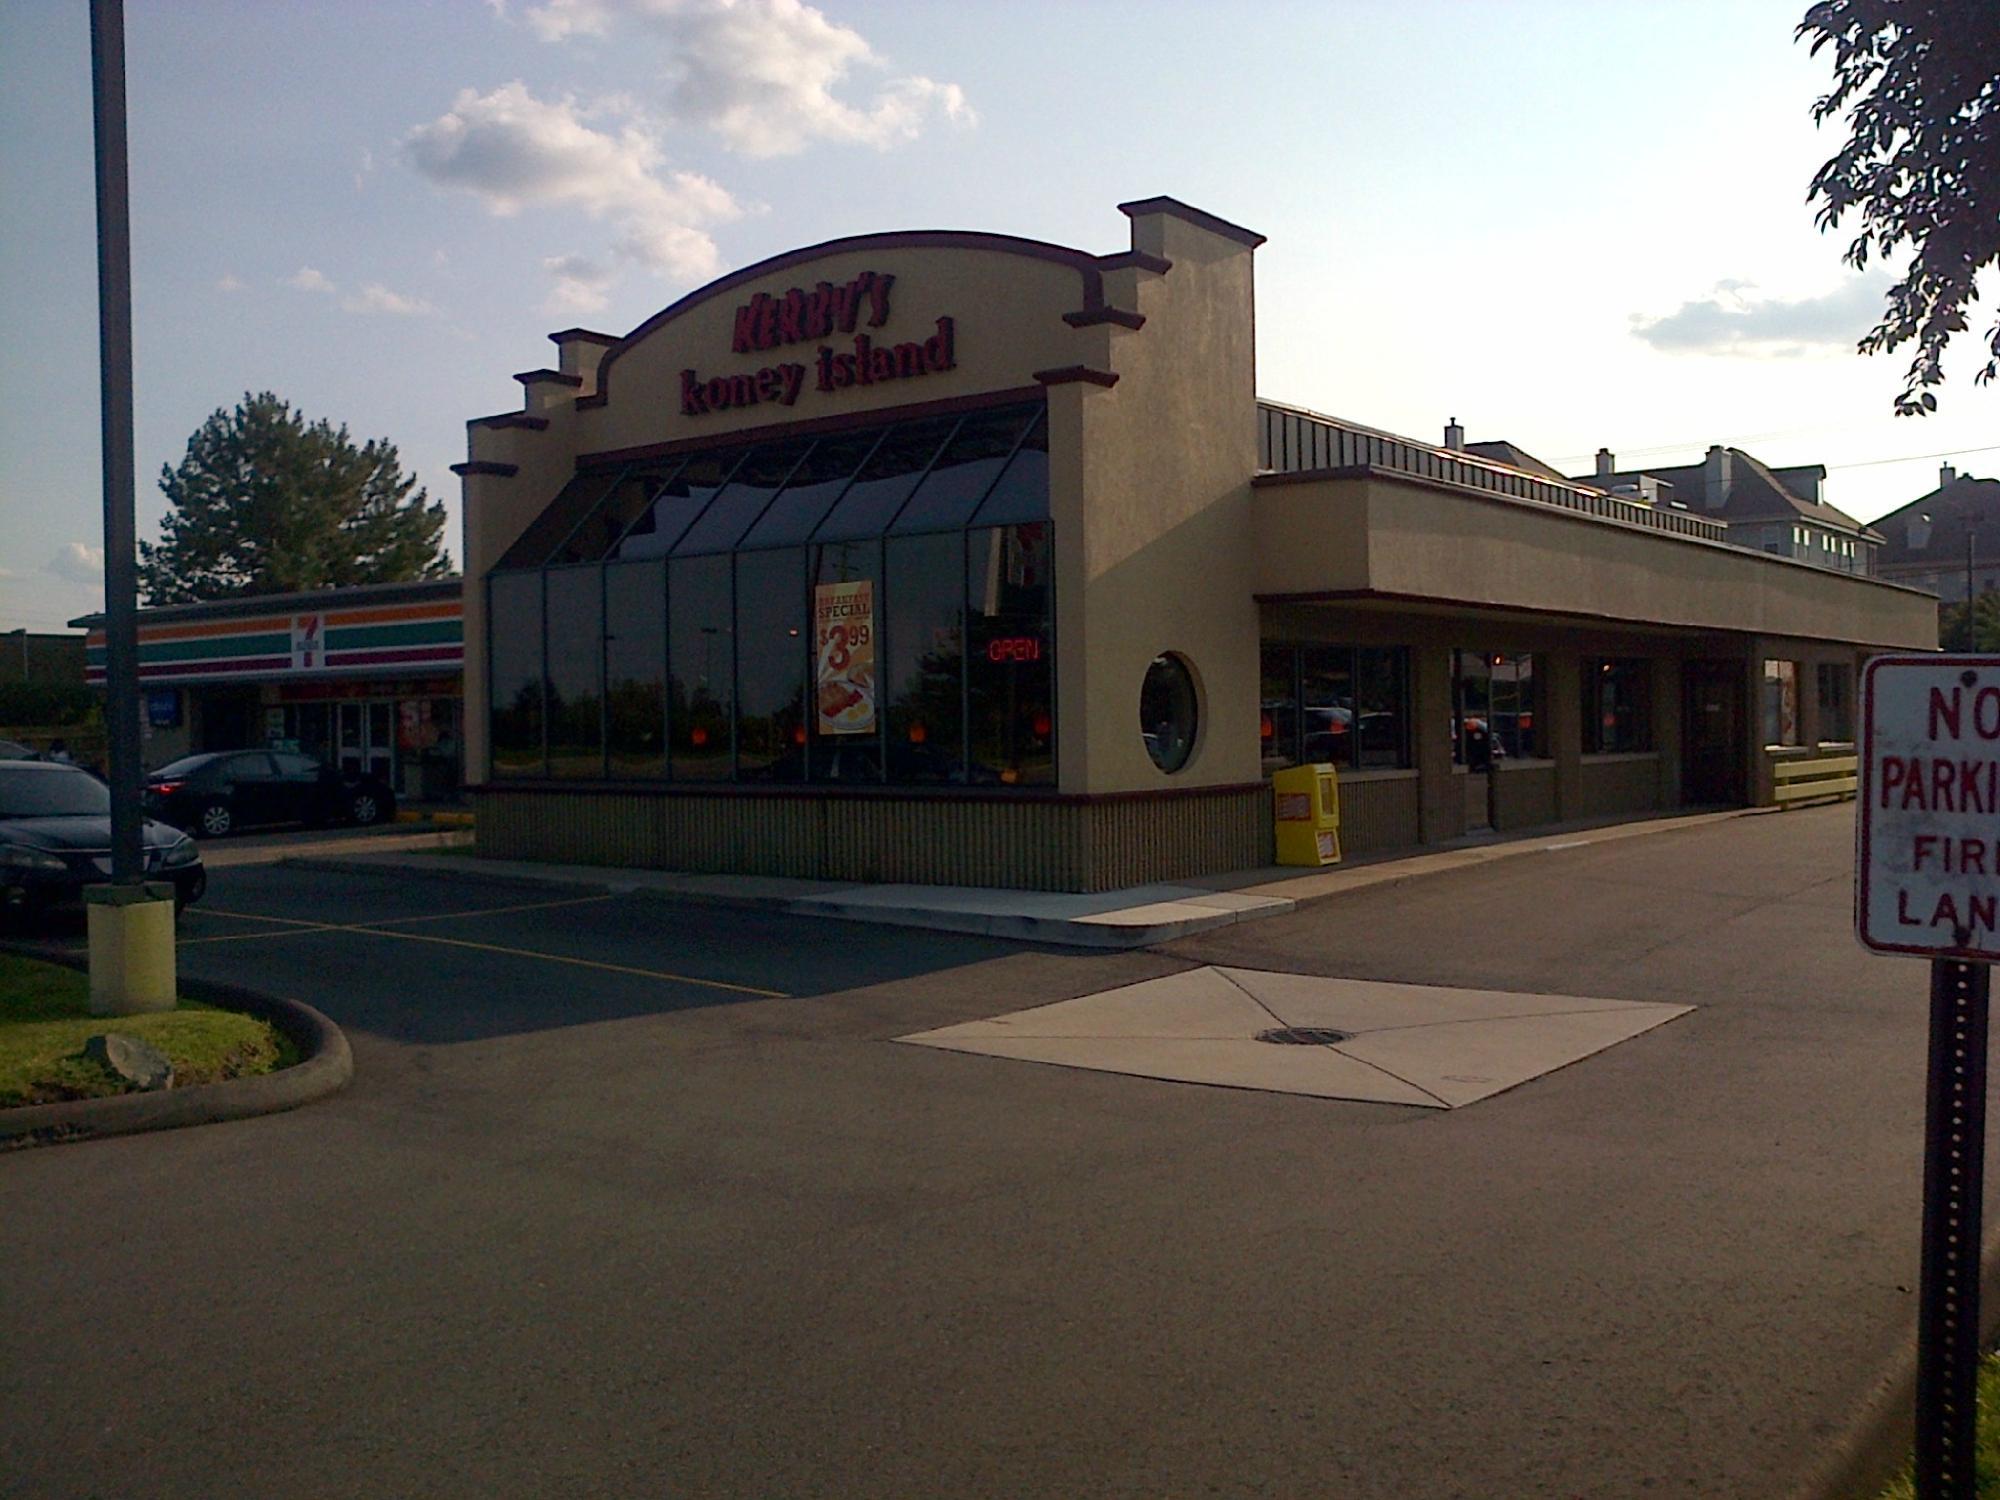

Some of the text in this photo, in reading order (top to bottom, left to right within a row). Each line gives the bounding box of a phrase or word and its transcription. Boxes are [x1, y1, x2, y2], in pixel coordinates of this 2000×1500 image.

[681, 316, 957, 415] koney island
[818, 604, 870, 618] SPECIAL
[989, 639, 1039, 661] OPEN
[1928, 687, 2000, 741] NO
[1913, 835, 2000, 876] FIR
